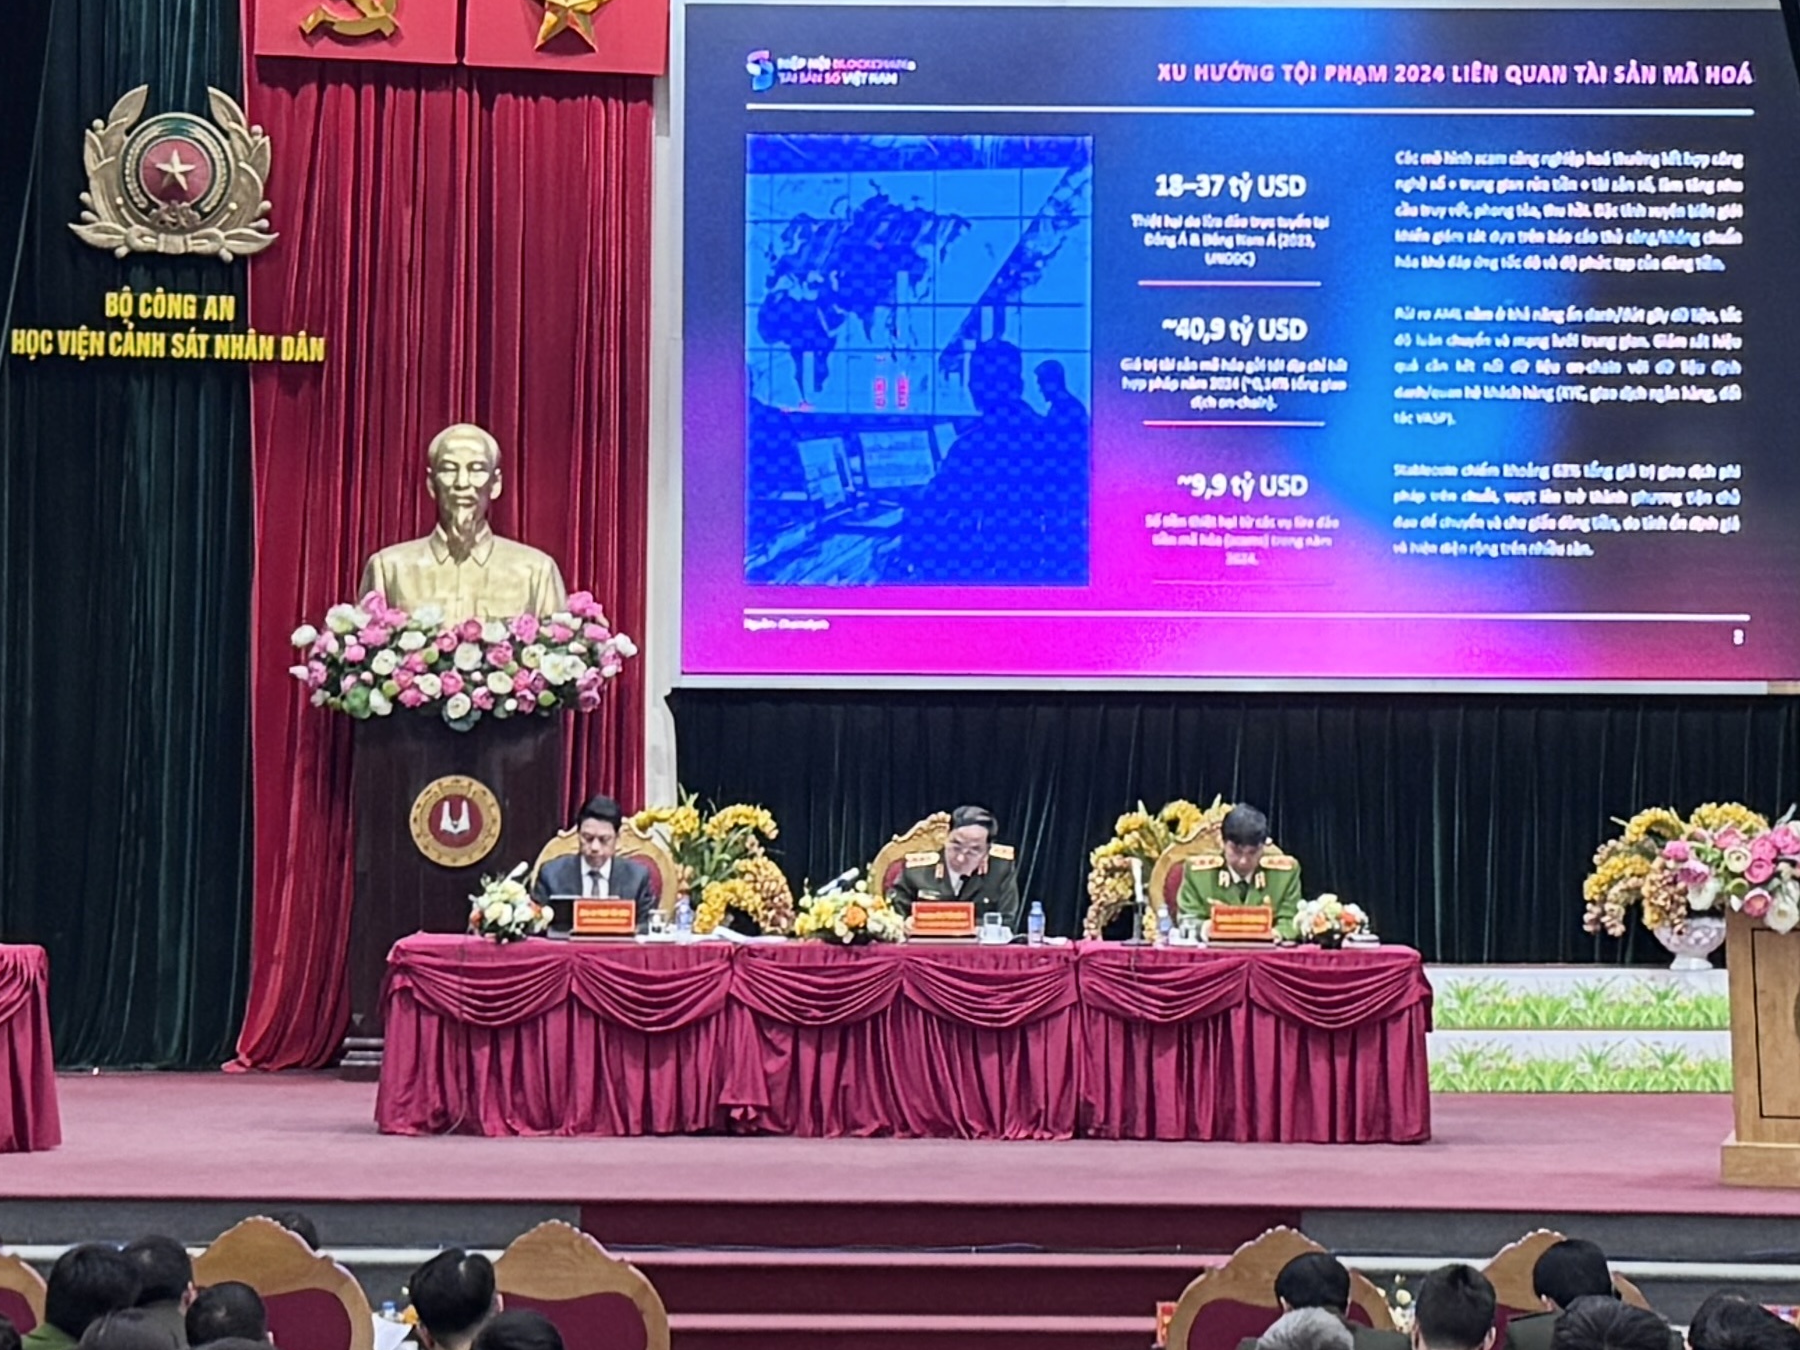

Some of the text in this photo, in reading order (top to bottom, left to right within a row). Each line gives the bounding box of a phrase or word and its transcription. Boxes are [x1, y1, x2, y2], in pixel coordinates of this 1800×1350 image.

[1157, 59, 1753, 86] XU HƯỚNG TỘI PHẠM 2024 LIÊN QUAN TÀI SẢN MÃ HOÁ
[1228, 171, 1253, 203] tỷ
[1257, 174, 1306, 198] USD
[105, 285, 235, 325] BỘ CÔNG AN
[11, 321, 325, 362] HỌC VIỆN CẢNH SÁT NHÂN DÂN
[1162, 314, 1308, 346] ~40,9 tỷ USD
[1177, 471, 1308, 502] ~9,9 tỷ USD
